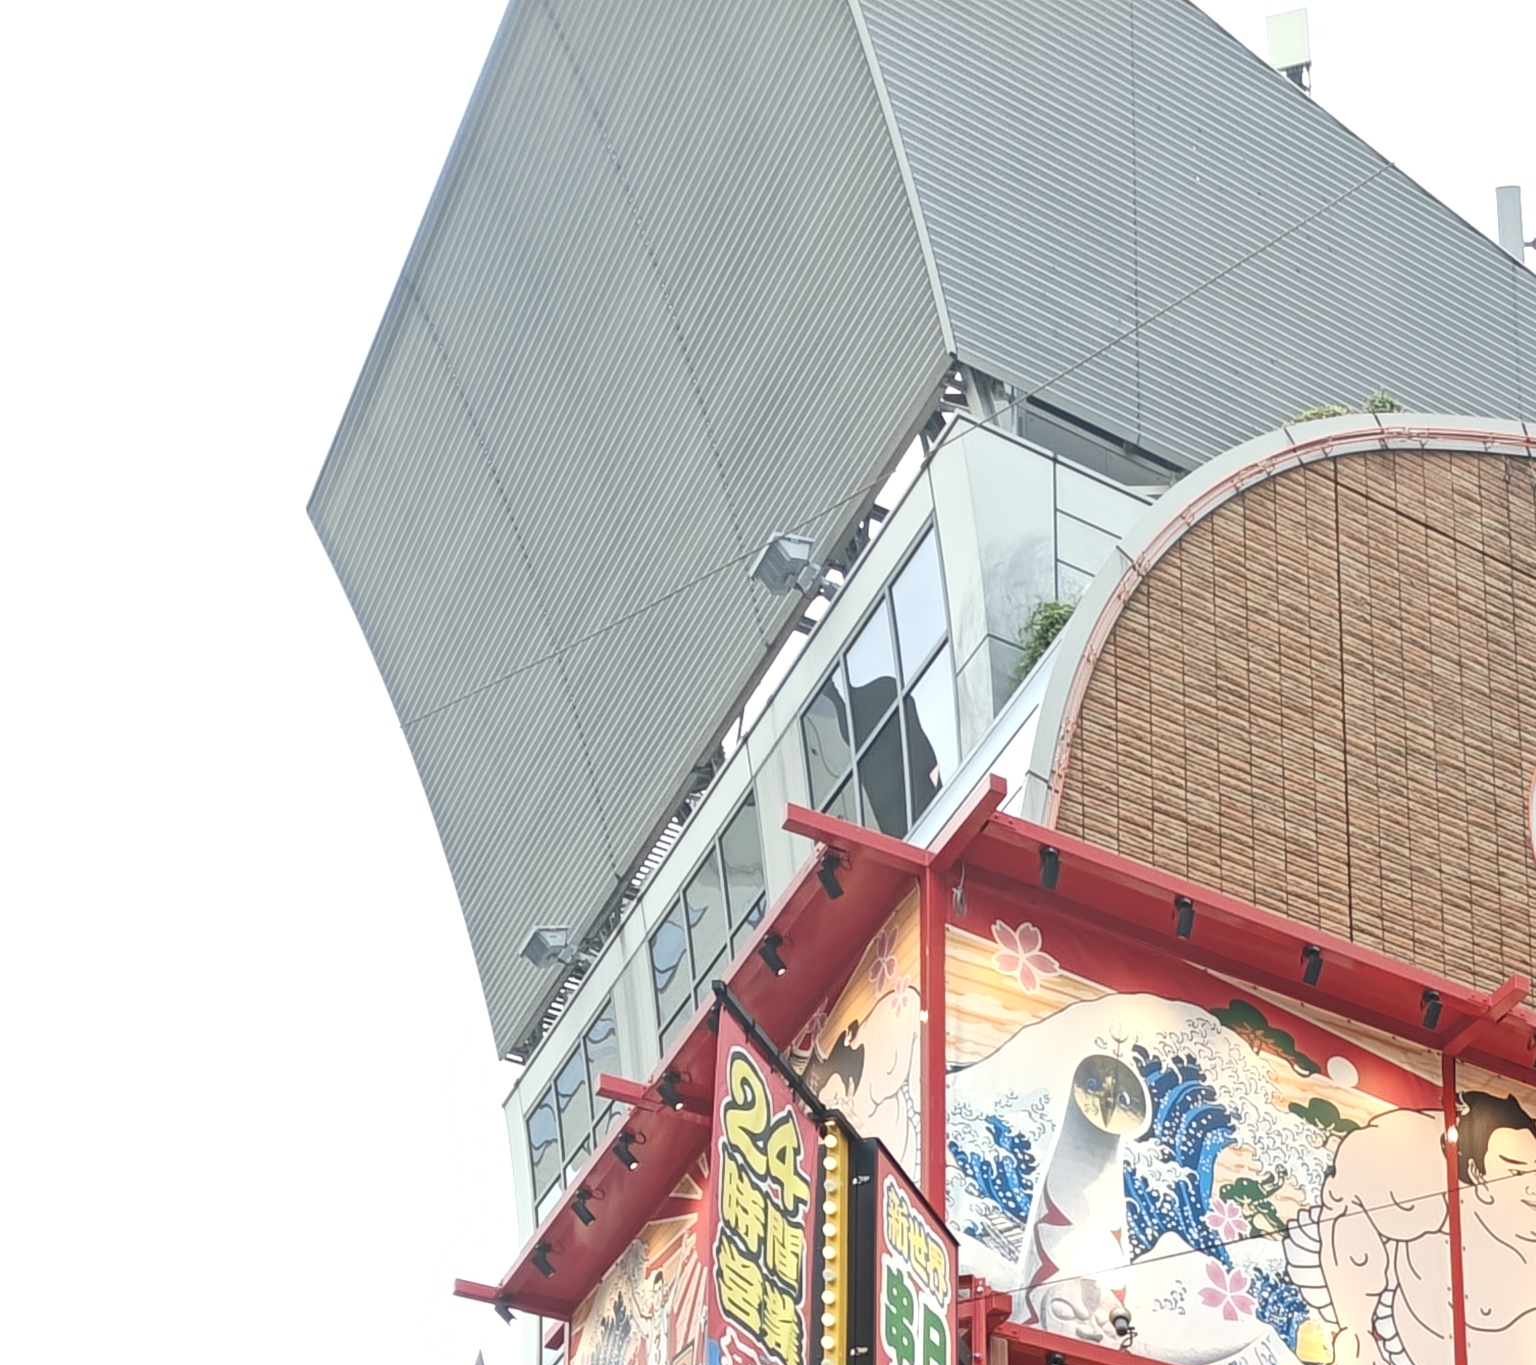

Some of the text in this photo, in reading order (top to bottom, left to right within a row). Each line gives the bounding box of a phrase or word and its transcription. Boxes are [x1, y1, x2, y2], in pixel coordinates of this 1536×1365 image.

[725, 1050, 810, 1217] 24
[721, 1142, 803, 1298] 時間
[888, 1182, 948, 1307] 新世界
